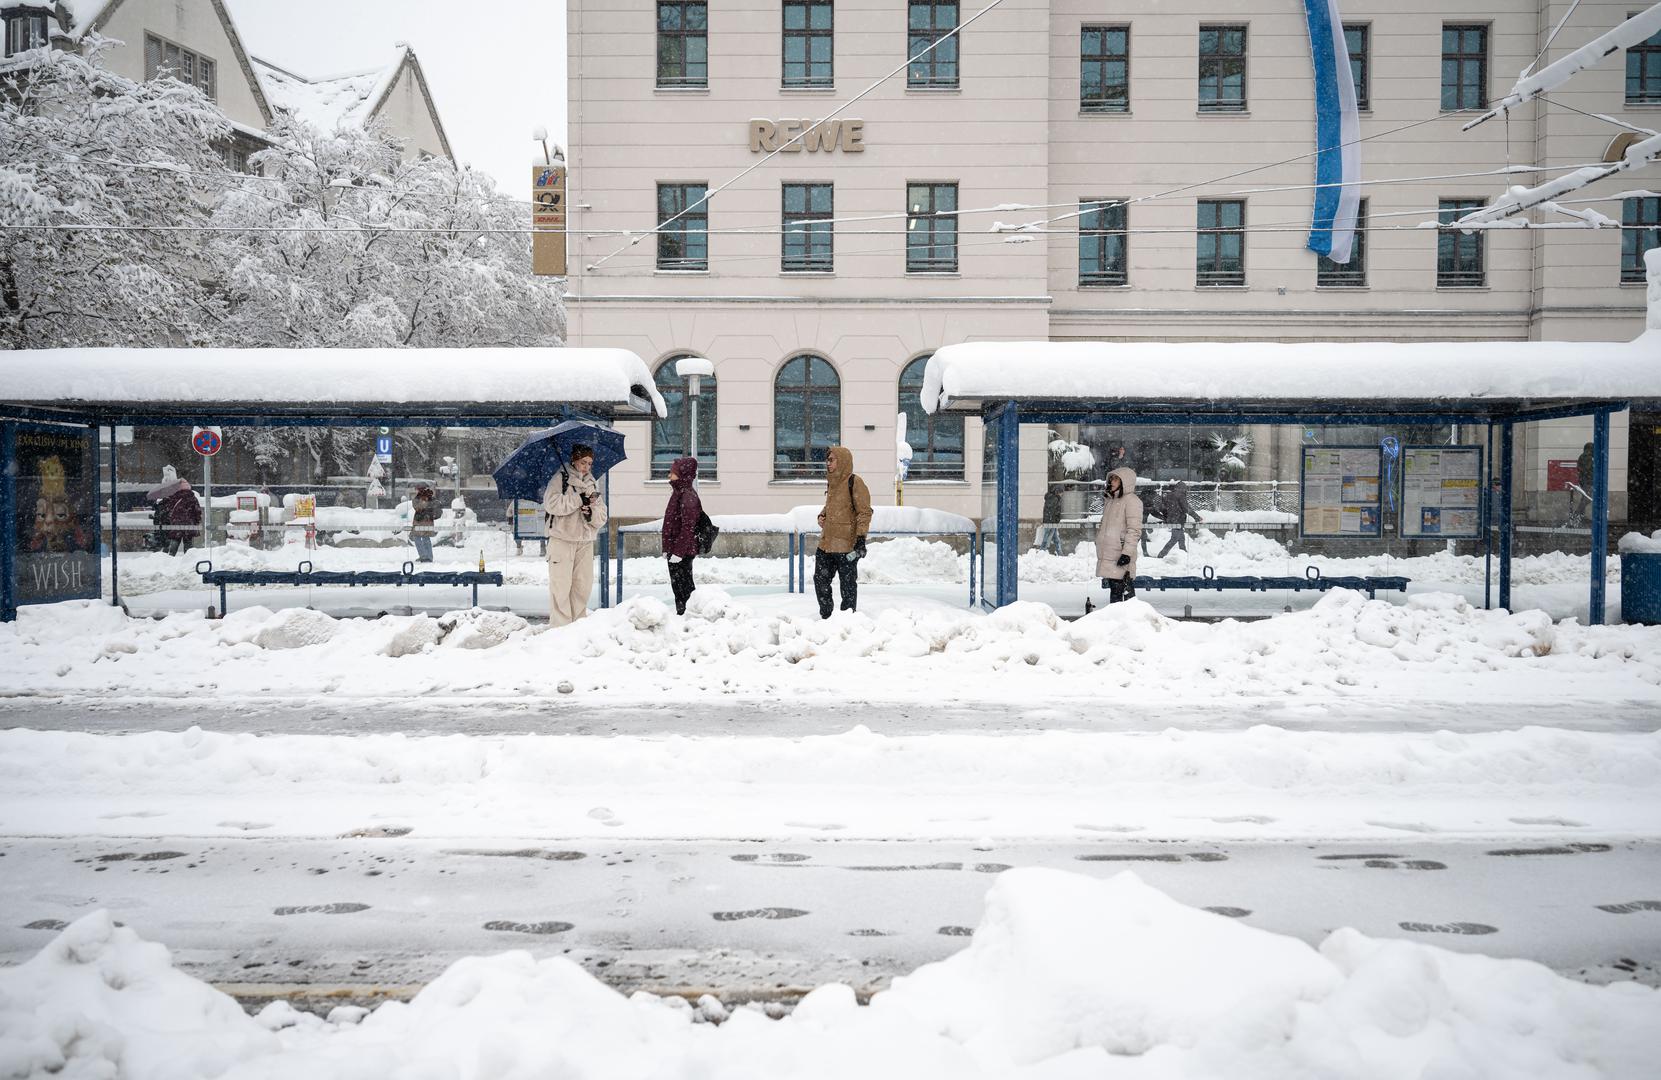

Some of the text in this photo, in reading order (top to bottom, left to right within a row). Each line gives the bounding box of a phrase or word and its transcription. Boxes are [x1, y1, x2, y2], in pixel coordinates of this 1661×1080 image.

[749, 118, 865, 153] REWE
[380, 439, 389, 452] U
[32, 560, 82, 590] WISH
